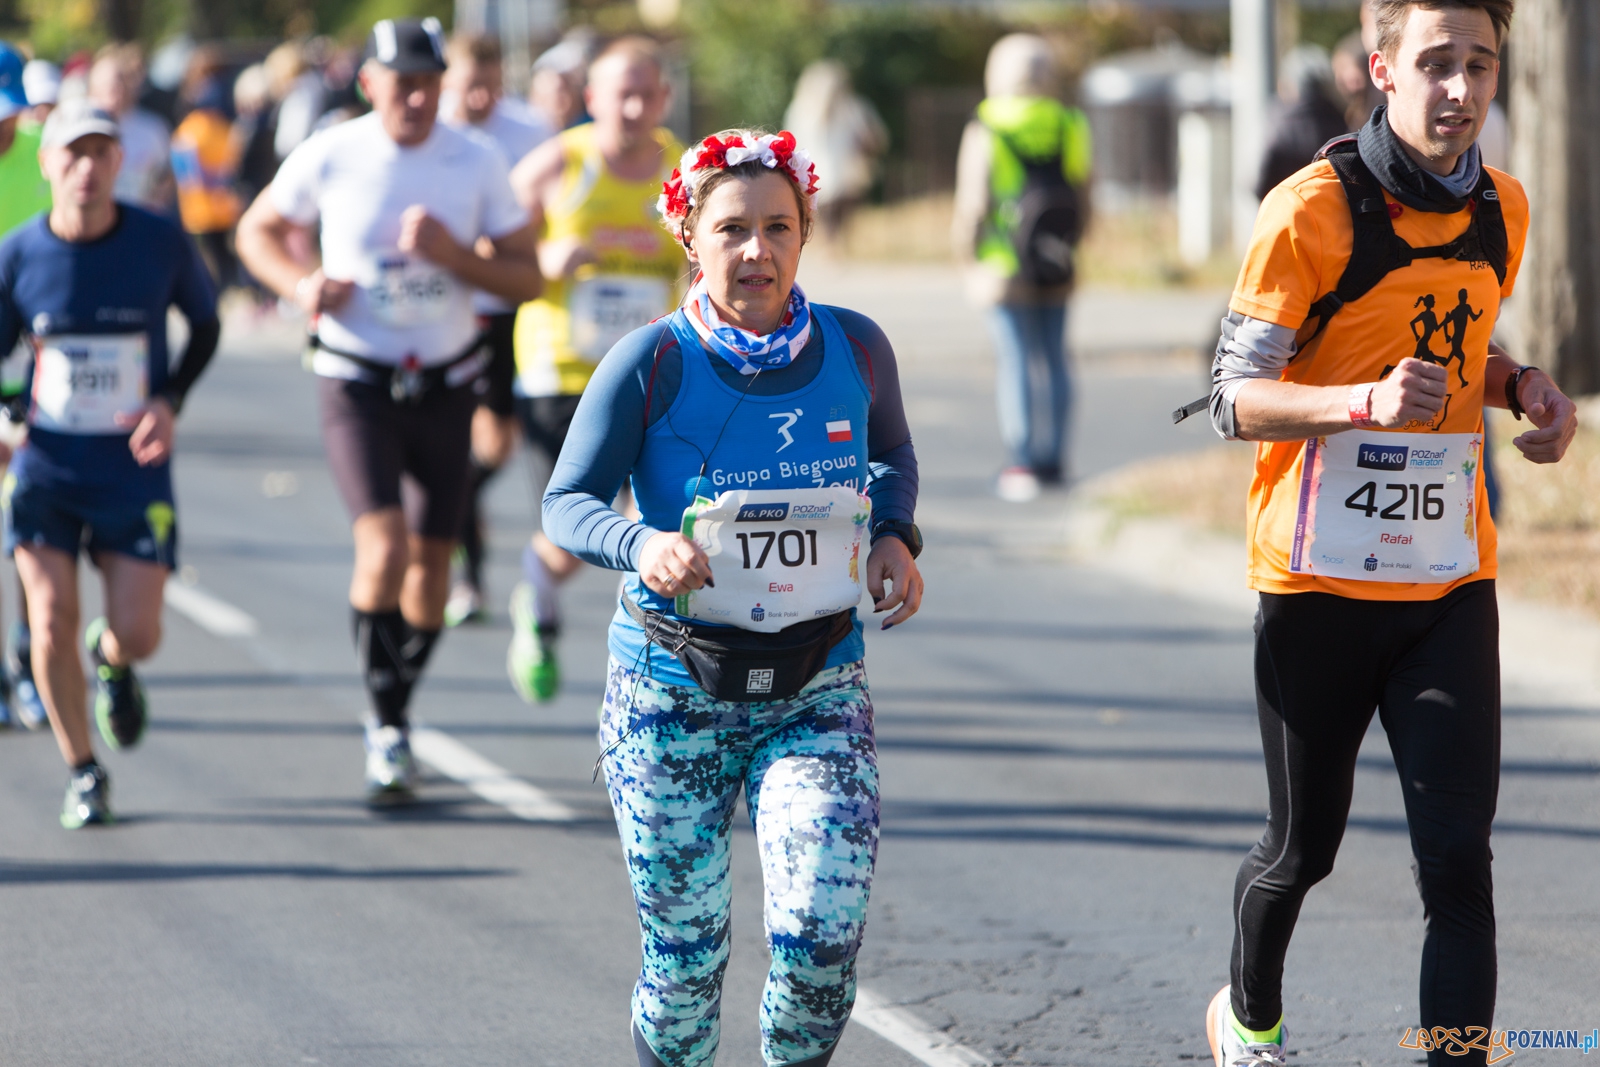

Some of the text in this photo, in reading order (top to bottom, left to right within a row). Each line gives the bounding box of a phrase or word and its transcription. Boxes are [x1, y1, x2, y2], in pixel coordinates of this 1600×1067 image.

[1362, 450, 1404, 464] 16. PKO
[1409, 456, 1443, 467] maraton
[712, 454, 857, 488] Grupa Biegowa
[1345, 481, 1444, 520] 4216
[742, 509, 784, 519] 16. PKO
[790, 511, 830, 519] maraton
[1380, 533, 1414, 545] Rafał
[736, 529, 817, 570] 1701
[1380, 561, 1412, 569] Bank Polski
[768, 582, 794, 593] Ewa
